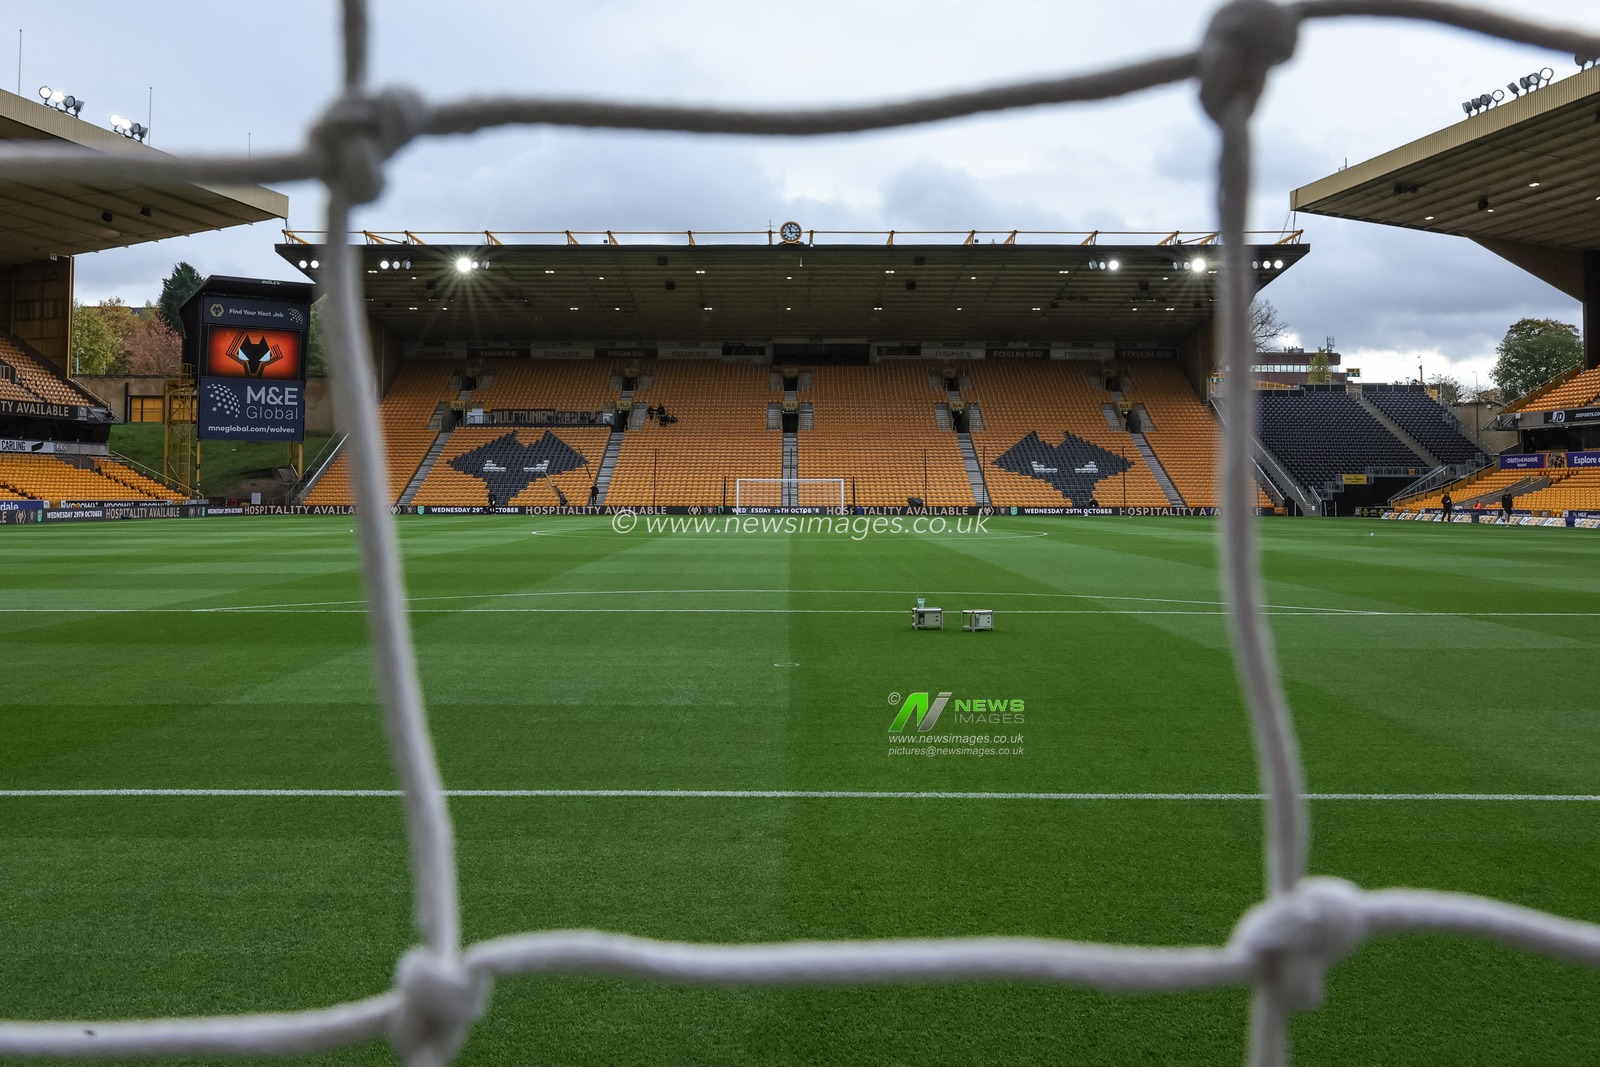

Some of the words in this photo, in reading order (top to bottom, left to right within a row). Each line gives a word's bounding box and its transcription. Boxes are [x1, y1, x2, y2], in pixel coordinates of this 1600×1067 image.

[246, 385, 299, 406] M&E
[16, 402, 69, 417] AVAILABLE
[245, 405, 298, 420] Global
[208, 425, 295, 434] mneglobal.com/wolves
[1, 440, 25, 451] CARLING
[1574, 456, 1597, 465] Explore
[105, 507, 147, 519] HOSPITALITY
[148, 507, 180, 517] AVAILABLE
[244, 505, 308, 515] HOSPITALITY
[525, 506, 601, 515] HOSPITALITY
[604, 506, 667, 515] AVAILABLE
[905, 506, 968, 516] AVAILABLE
[1119, 507, 1196, 516] HOSPITALITY
